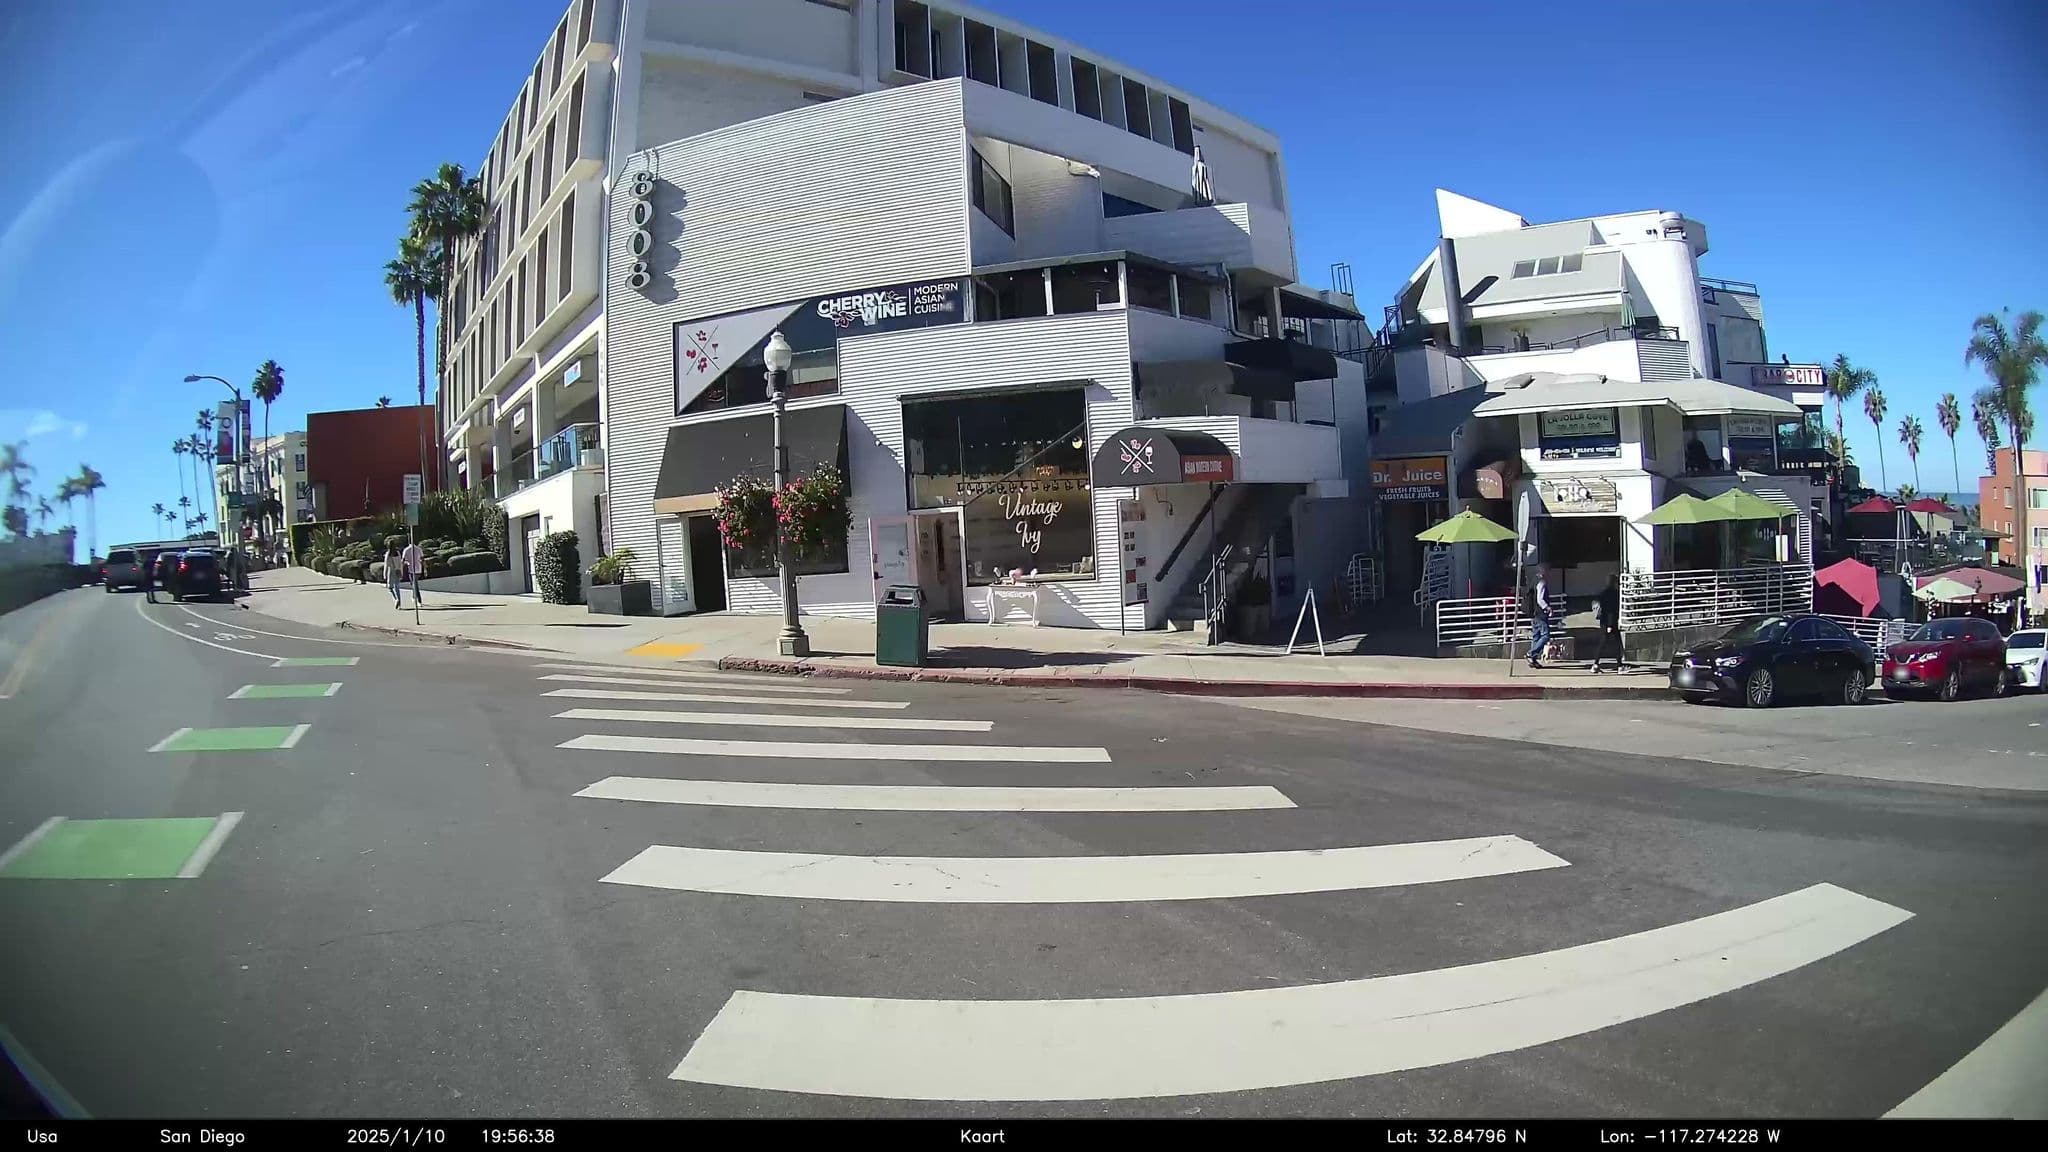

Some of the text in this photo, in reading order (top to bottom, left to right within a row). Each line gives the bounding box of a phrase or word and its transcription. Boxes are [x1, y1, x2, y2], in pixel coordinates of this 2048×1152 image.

[625, 170, 653, 291] 8008
[914, 283, 958, 296] MODERN
[817, 291, 887, 315] CHERRY
[914, 294, 945, 305] ASIAN
[862, 301, 907, 322] WINE
[1796, 369, 1820, 383] CITY
[1372, 469, 1442, 483] Dr. Juice
[1417, 491, 1441, 499] JUICES
[998, 493, 1062, 525] Vintage
[1016, 521, 1041, 553] Ivy
